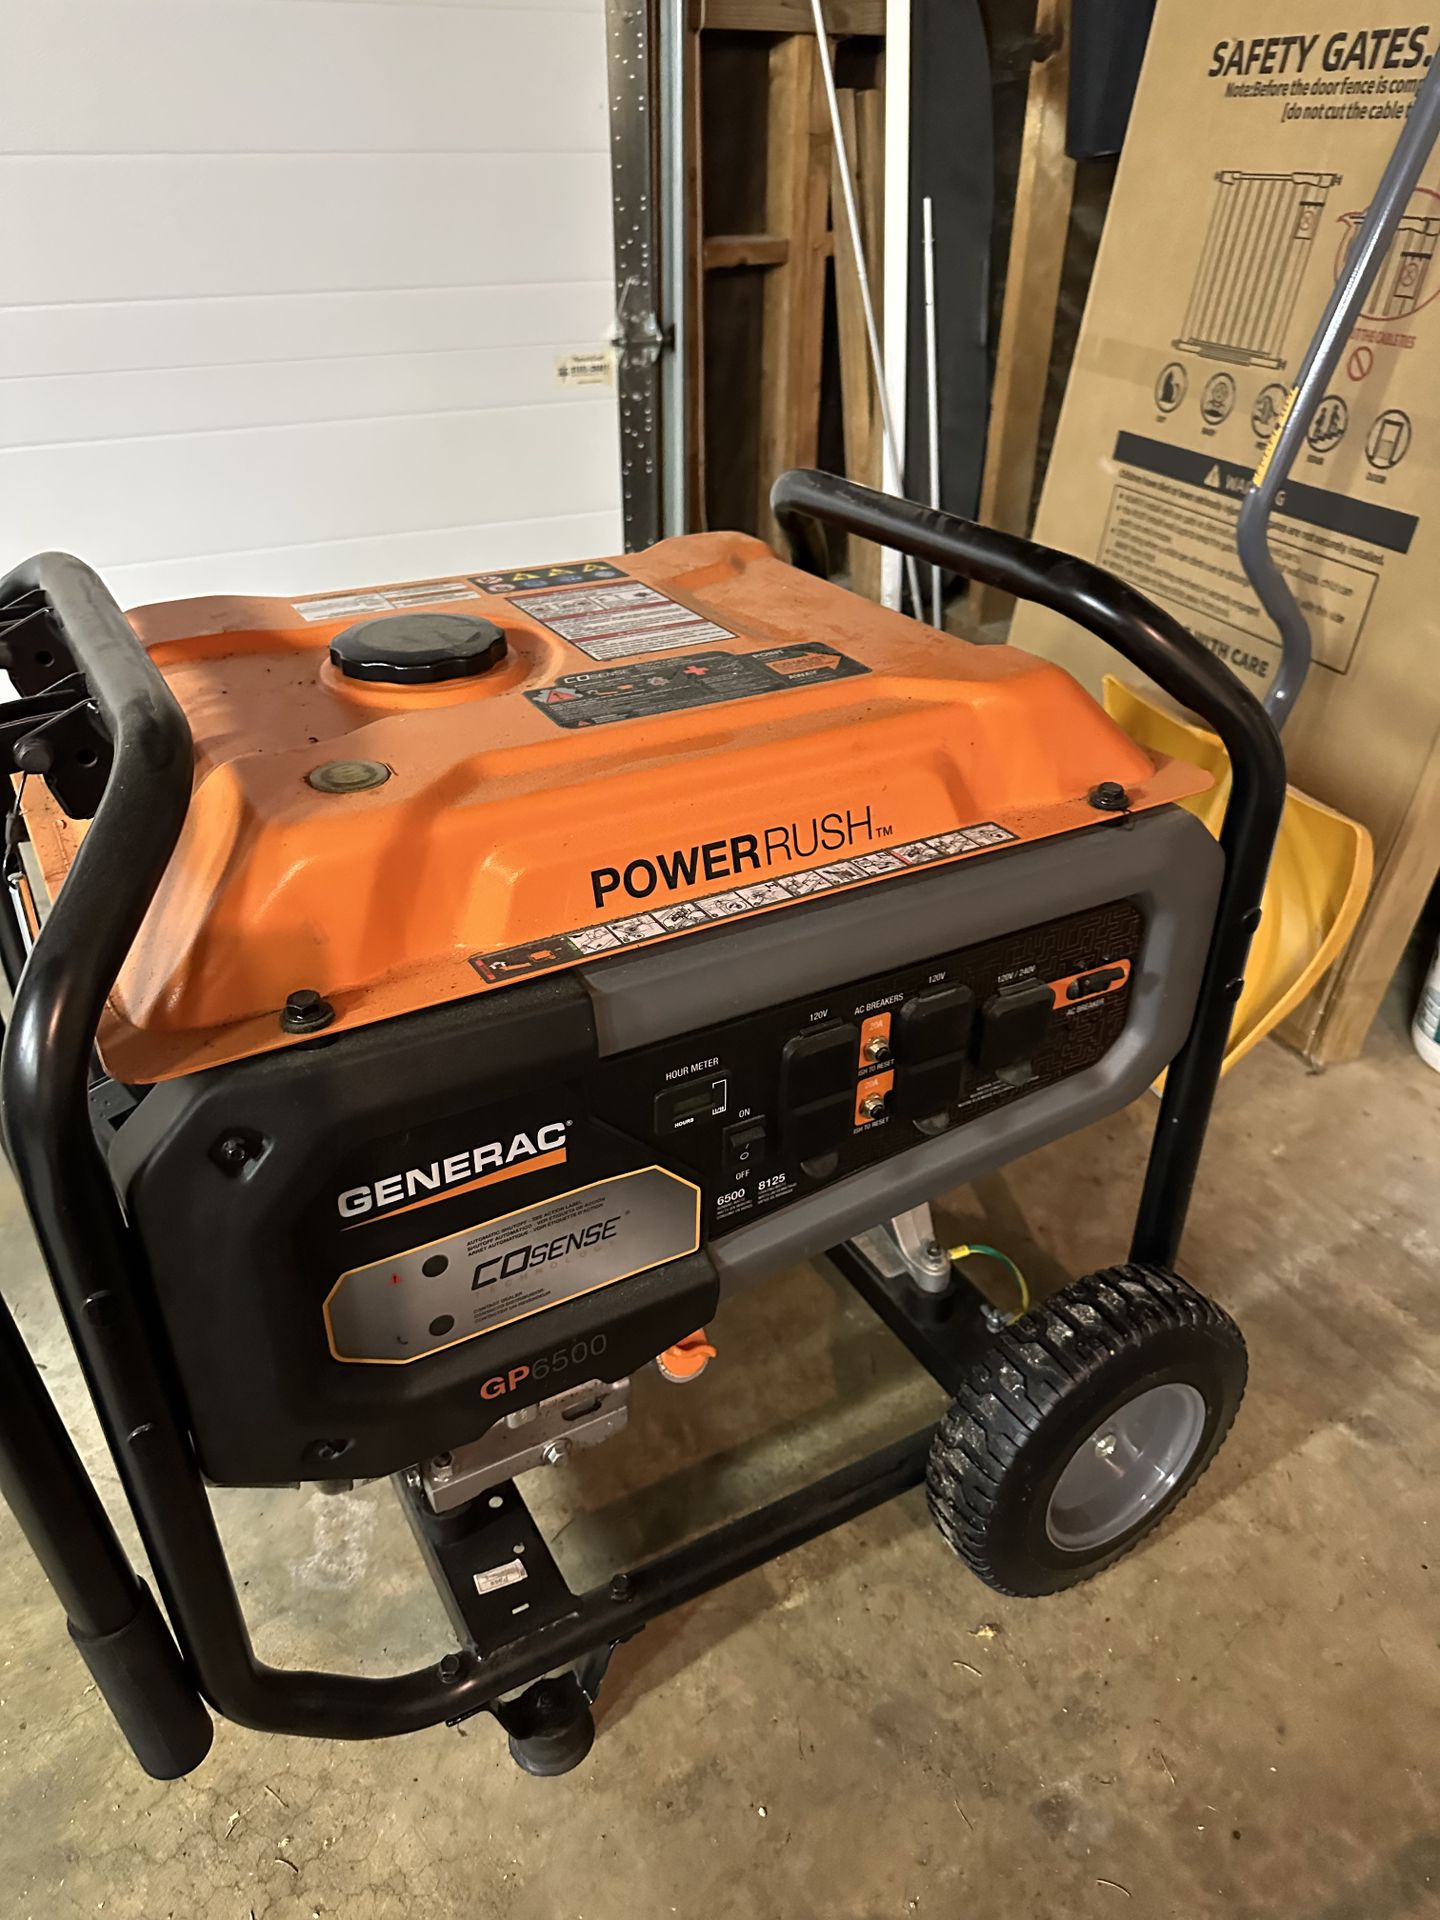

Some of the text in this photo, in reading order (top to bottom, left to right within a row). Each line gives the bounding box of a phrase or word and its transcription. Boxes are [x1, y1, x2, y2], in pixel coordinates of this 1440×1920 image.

[1208, 34, 1320, 77] SAFETY
[1290, 78, 1309, 95] the
[1310, 77, 1339, 95] door
[1340, 76, 1372, 94] fence
[1375, 75, 1387, 93] is
[1303, 103, 1324, 120] not
[1324, 102, 1346, 119] cut
[1347, 102, 1366, 119] the
[1368, 101, 1404, 119] cable
[1231, 648, 1269, 678] CARE
[590, 805, 873, 908] POWERRUSH
[928, 972, 946, 984] 120V
[809, 1009, 828, 1022] 120V
[854, 993, 904, 1016] AC BREAKERS
[665, 1057, 719, 1081] HOUR METER
[674, 1117, 695, 1128] HOURS
[738, 1108, 750, 1118] ON
[337, 1122, 566, 1218] GENERAC
[735, 1169, 750, 1181] OFF
[717, 1188, 746, 1206] 6500
[758, 1173, 786, 1191] 8125
[467, 1231, 500, 1246] AUTOMATIC
[501, 1220, 527, 1234] SHUTOFF
[467, 1239, 494, 1251] SHUTOFF
[471, 1216, 621, 1291] COSENSE
[480, 1334, 607, 1400] GP6500
